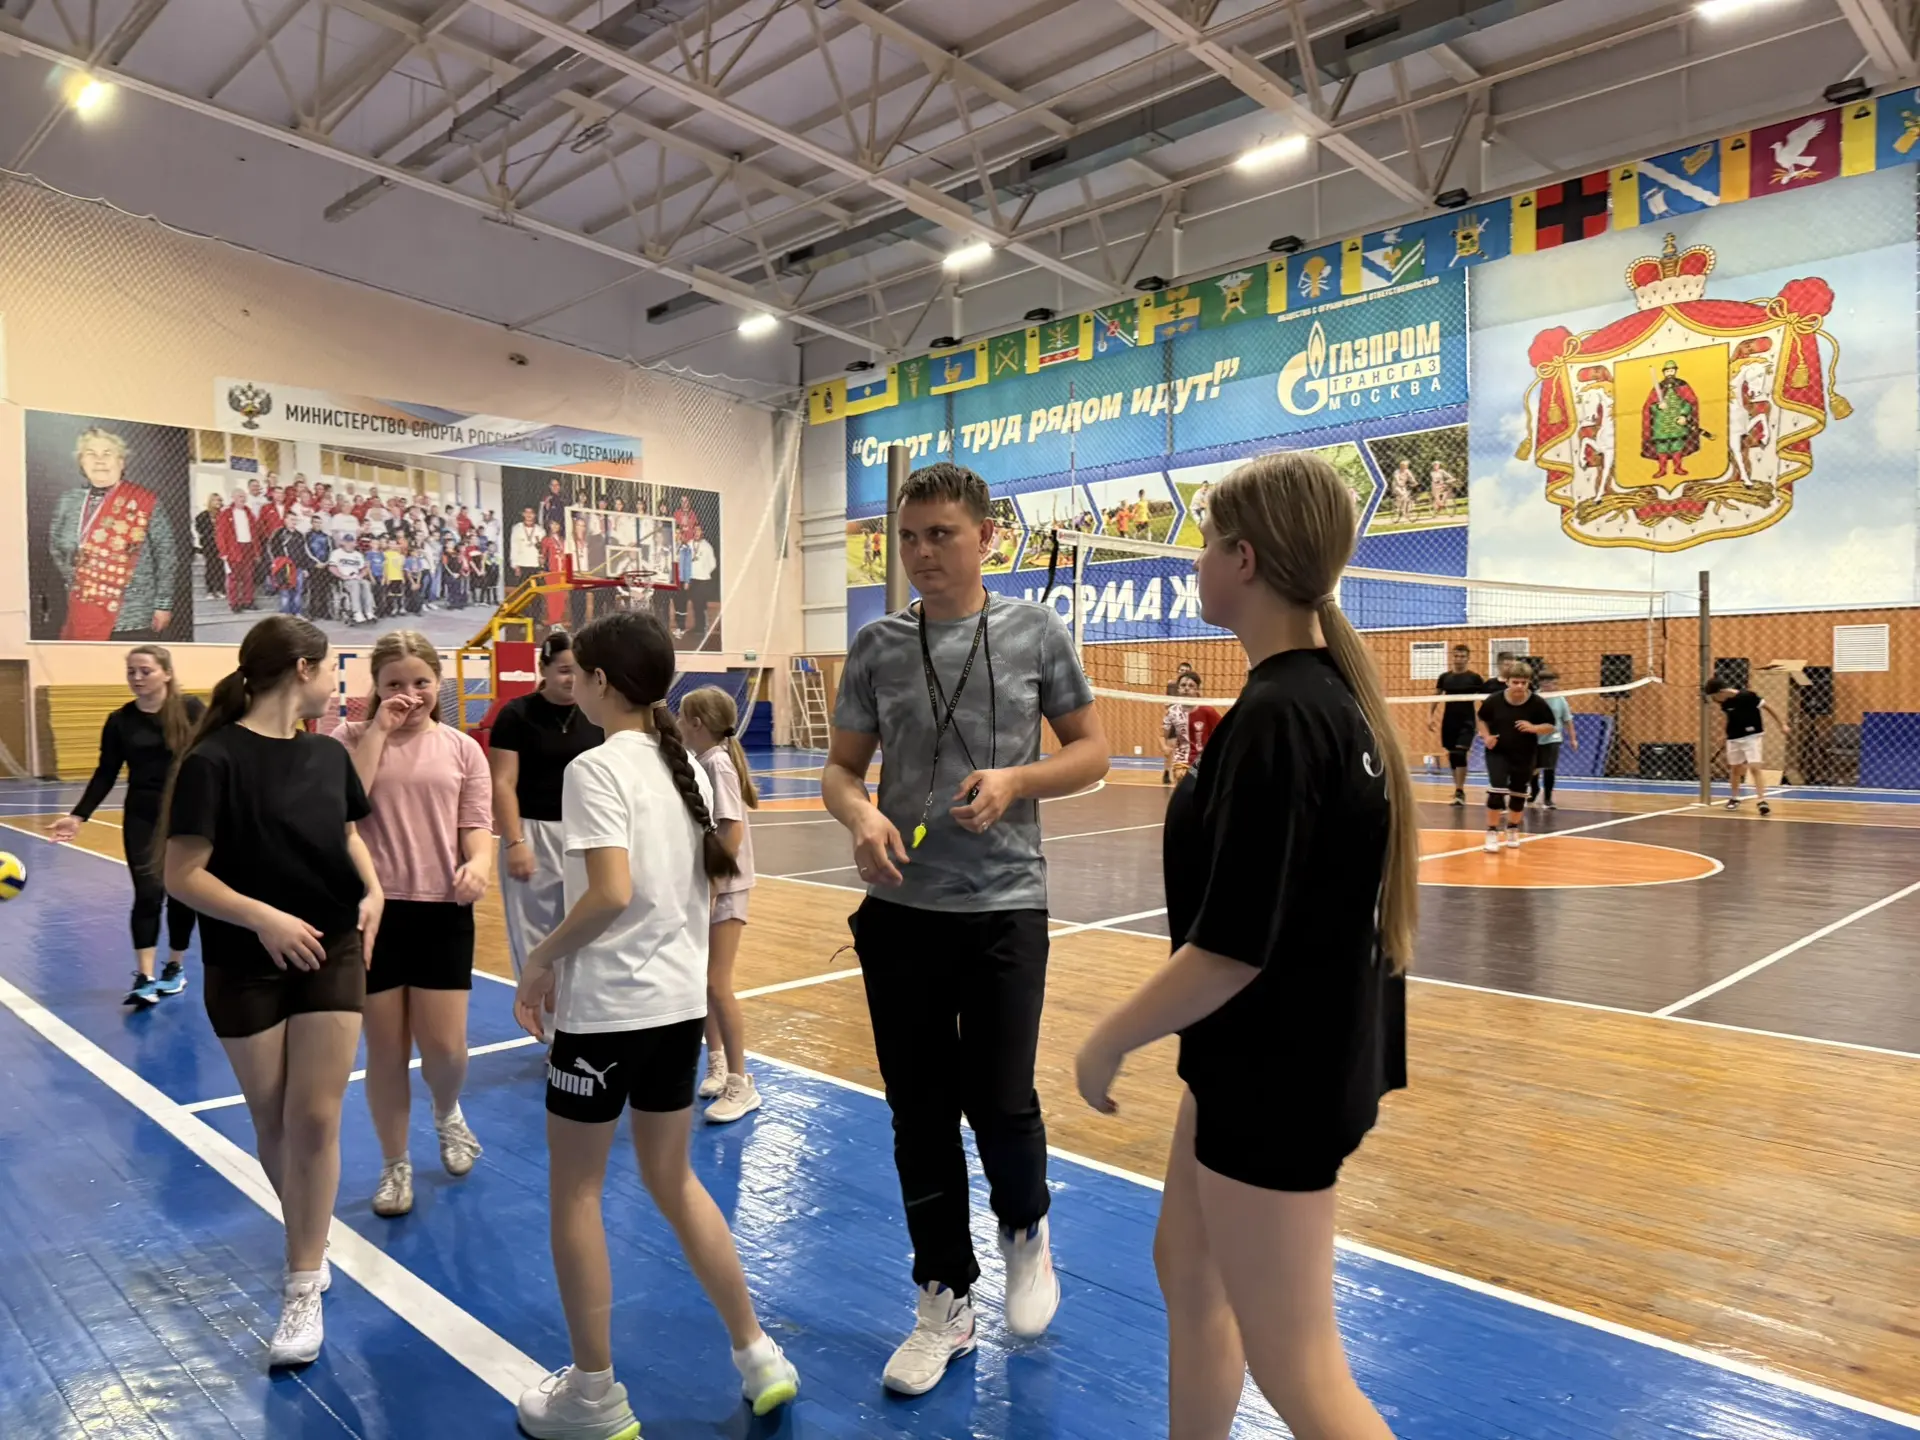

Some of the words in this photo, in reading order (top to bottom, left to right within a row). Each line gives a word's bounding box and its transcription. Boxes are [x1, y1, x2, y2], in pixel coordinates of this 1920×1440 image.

[1329, 321, 1440, 375] ГАЗПРОМ
[1332, 359, 1437, 391] ТРАНСГАЗ
[1329, 377, 1441, 411] МОСКВА
[285, 403, 406, 436] МИНИСТЕРСТВО
[411, 420, 464, 444] СПОРТА
[468, 428, 556, 455] РОСССКОЙ
[561, 442, 634, 466] ФЕДЕРАЦИИ
[960, 414, 1022, 453] труд
[1028, 392, 1123, 442] рядом
